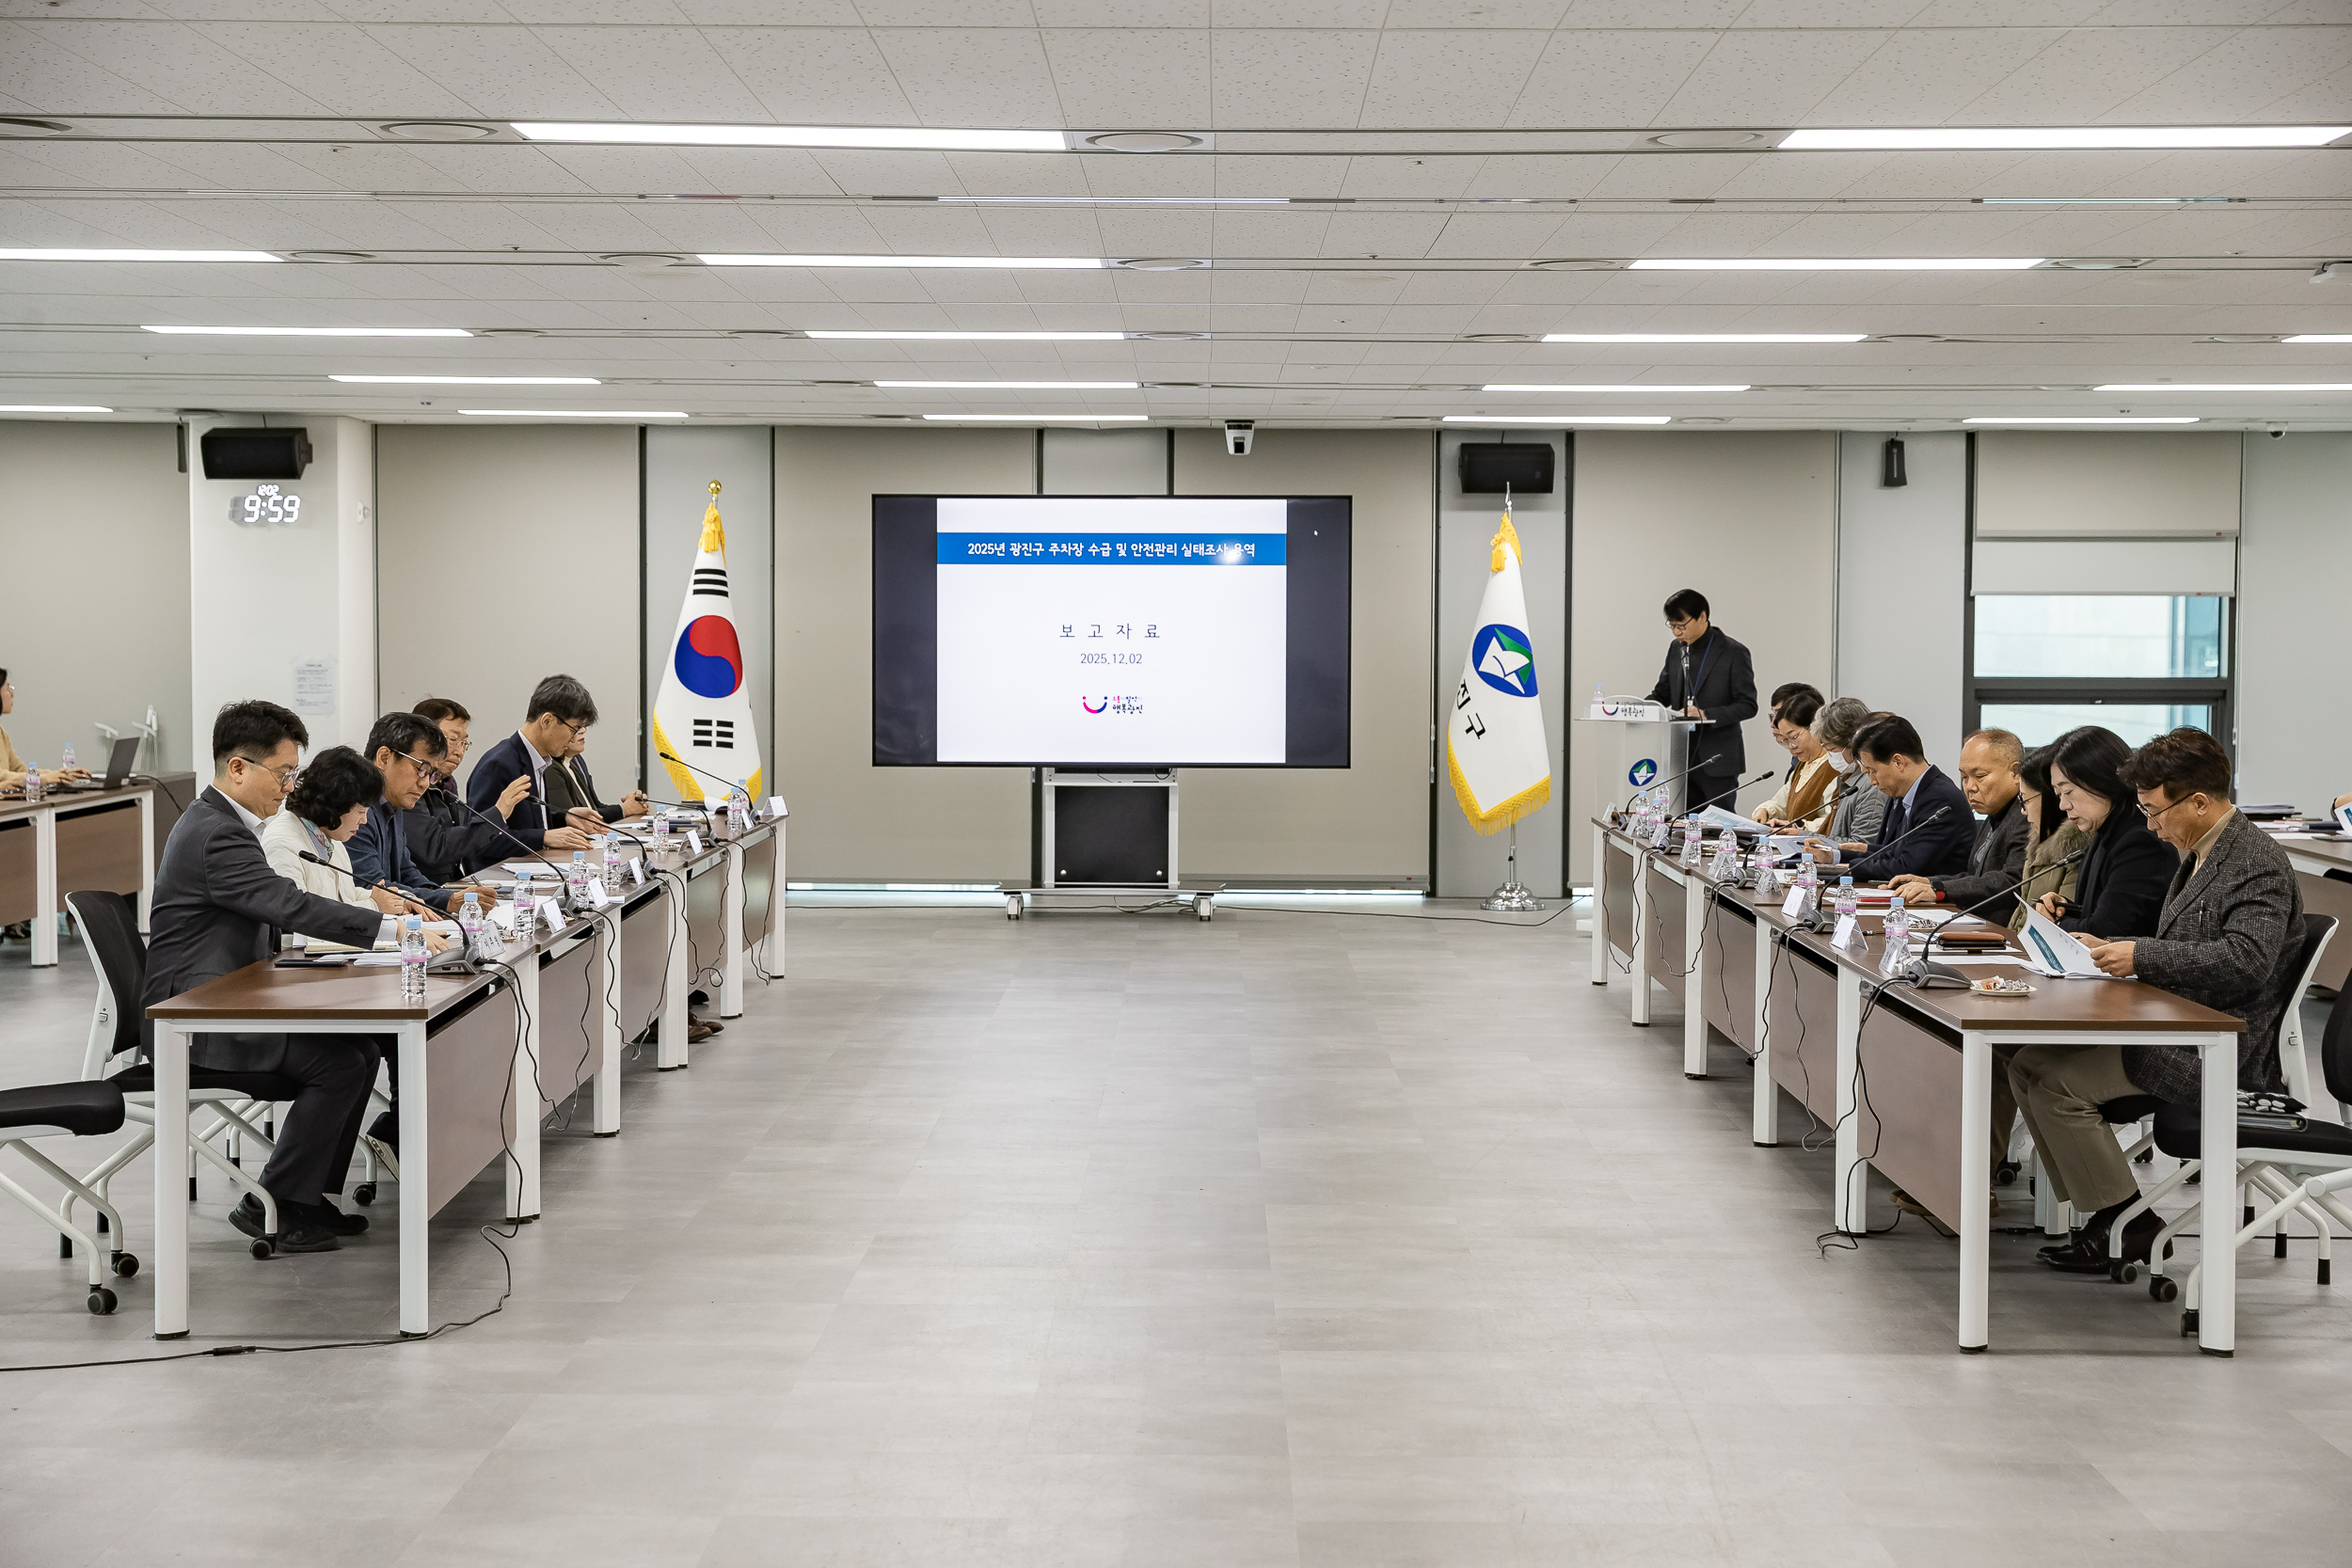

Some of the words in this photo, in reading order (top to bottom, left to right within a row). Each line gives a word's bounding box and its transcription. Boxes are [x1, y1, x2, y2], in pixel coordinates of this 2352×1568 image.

[244, 495, 301, 523] 9:59
[967, 542, 1006, 557] 2025년
[1009, 542, 1045, 557] 광진구
[1048, 542, 1085, 557] 주차장
[1088, 542, 1113, 557] 수급
[1116, 542, 1127, 557] 및
[1130, 542, 1178, 557] 안전관리
[1181, 542, 1229, 557] 실태조사
[1232, 542, 1256, 558] 용역
[1080, 653, 1143, 665] 2025.12.02
